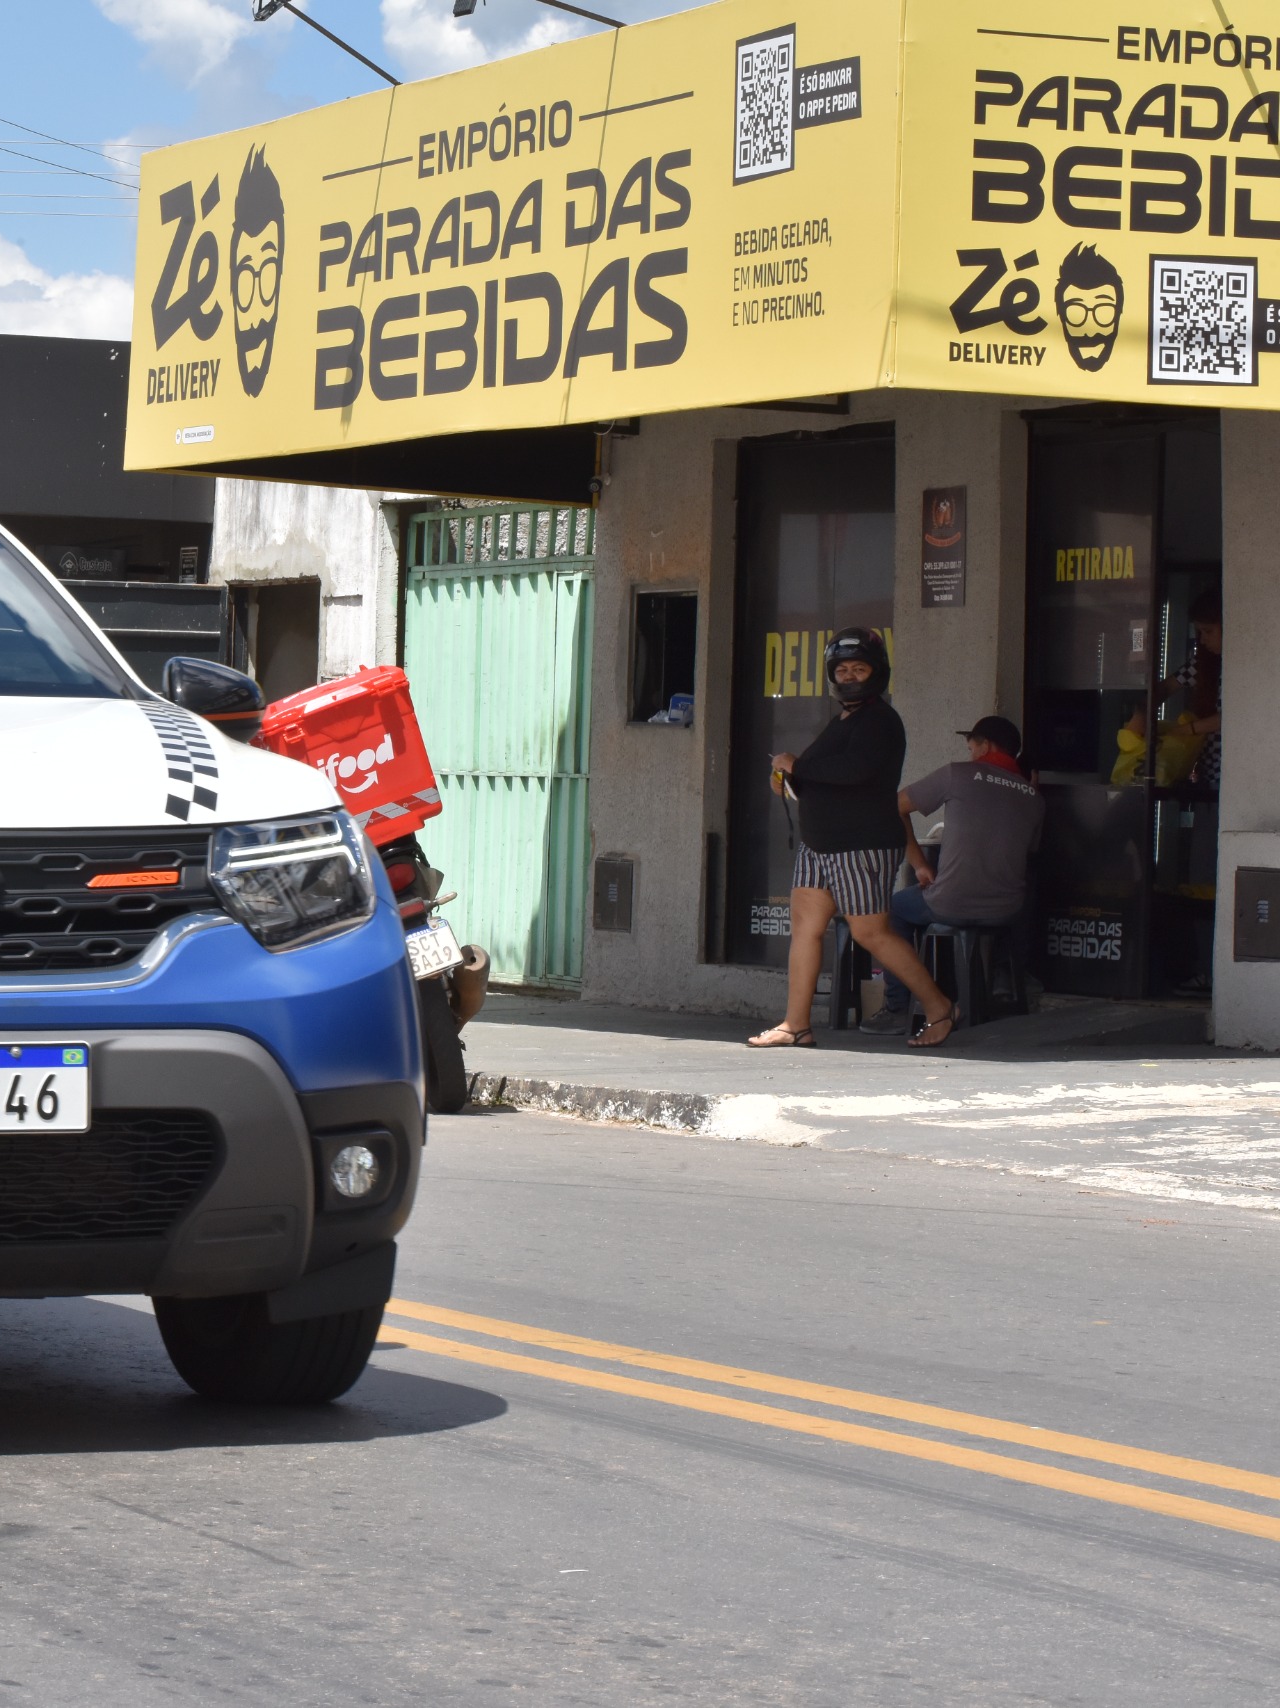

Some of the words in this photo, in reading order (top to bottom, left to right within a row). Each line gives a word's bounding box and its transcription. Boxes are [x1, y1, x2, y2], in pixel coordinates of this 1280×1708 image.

[1117, 24, 1280, 71] EMPÓRI
[800, 73, 805, 94] É
[806, 71, 817, 93] SÓ
[819, 67, 852, 90] BAIXAR
[799, 101, 806, 119] O
[807, 98, 824, 117] APP
[825, 96, 831, 114] E
[832, 91, 857, 112] PEDIR
[974, 69, 1279, 146] PARADA
[419, 100, 573, 180] EMPÓRIO
[971, 138, 1280, 240] BEBID
[318, 179, 543, 293] PARADA
[564, 148, 692, 248] DAS
[734, 226, 777, 257] BEBIDA
[781, 217, 832, 247] GELADA,
[151, 172, 223, 351] Zé
[733, 266, 750, 292] EM
[753, 257, 808, 289] MINUTOS
[732, 302, 739, 326] E
[742, 300, 759, 325] NO
[762, 291, 825, 323] PRECINHO.
[948, 247, 1049, 336] Zé
[314, 246, 689, 410] BEBIDAS
[1267, 304, 1275, 322] É
[948, 341, 1047, 367] DELIVERY
[147, 359, 221, 406] DELIVERY
[1056, 545, 1134, 582] RETIRADA
[973, 771, 982, 780] A
[986, 774, 1036, 796] SERVIÇO
[126, 874, 173, 883] ICONIC
[750, 918, 792, 936] BEBID
[751, 906, 790, 918] PARADA
[1048, 918, 1095, 935] PARADA
[1098, 921, 1123, 937] DAS
[1047, 934, 1122, 961] BEBIDAS
